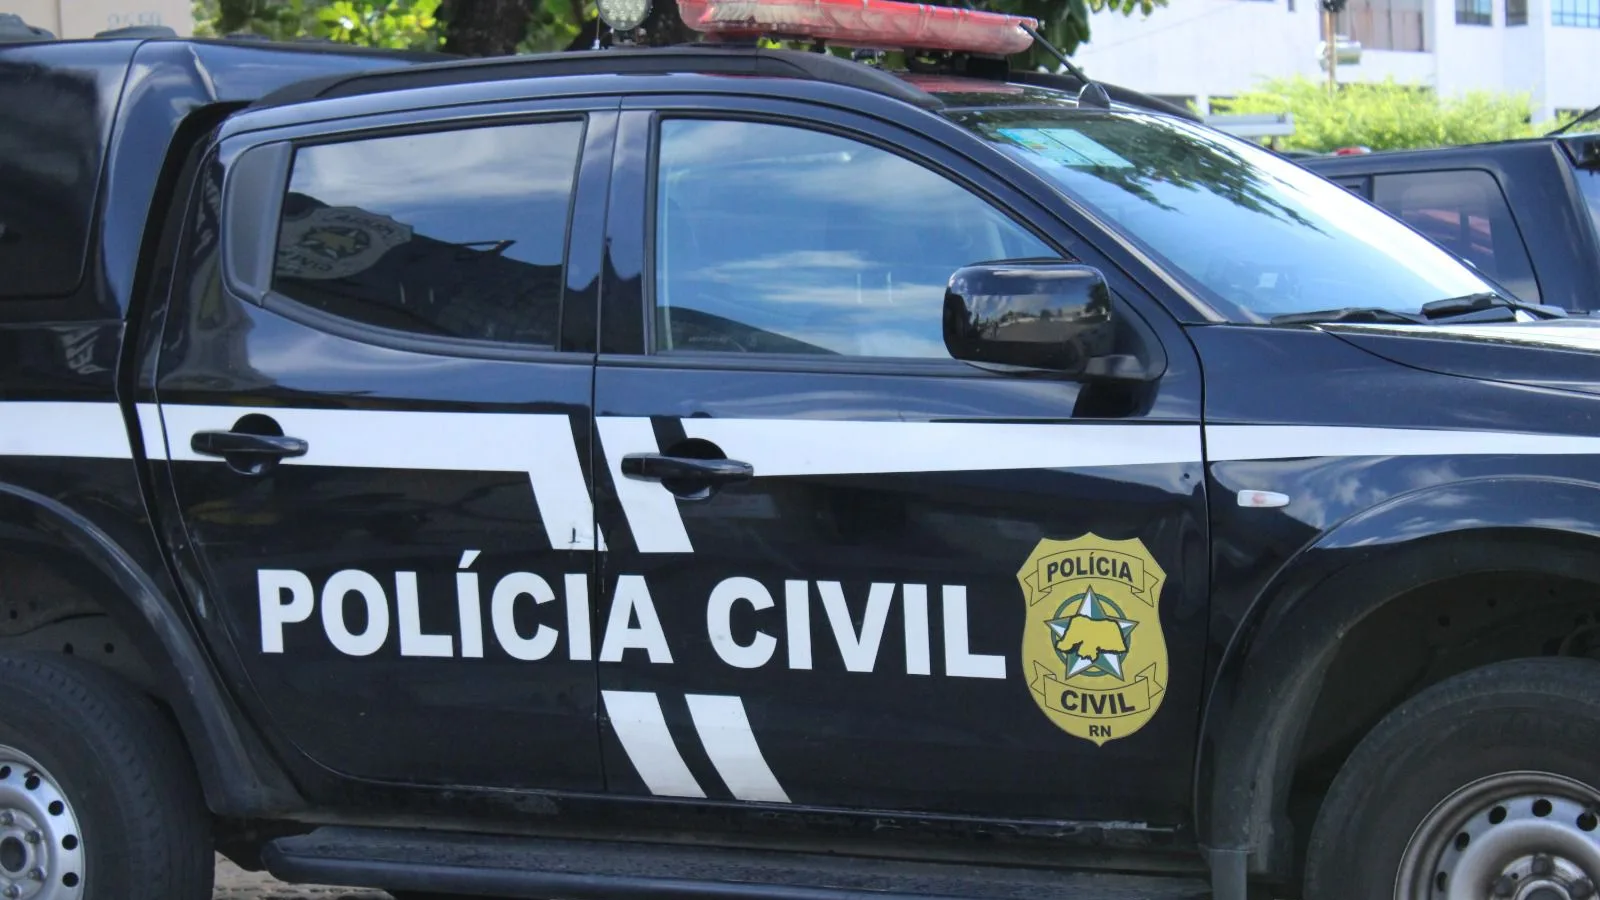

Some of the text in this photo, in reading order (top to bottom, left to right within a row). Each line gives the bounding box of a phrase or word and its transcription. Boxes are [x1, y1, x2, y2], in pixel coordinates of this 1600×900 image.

[1047, 552, 1133, 583] POLÍCIA
[257, 550, 1007, 679] POLÍCIA CIVIL
[1060, 690, 1136, 715] CIVIL
[1088, 725, 1112, 738] RN
